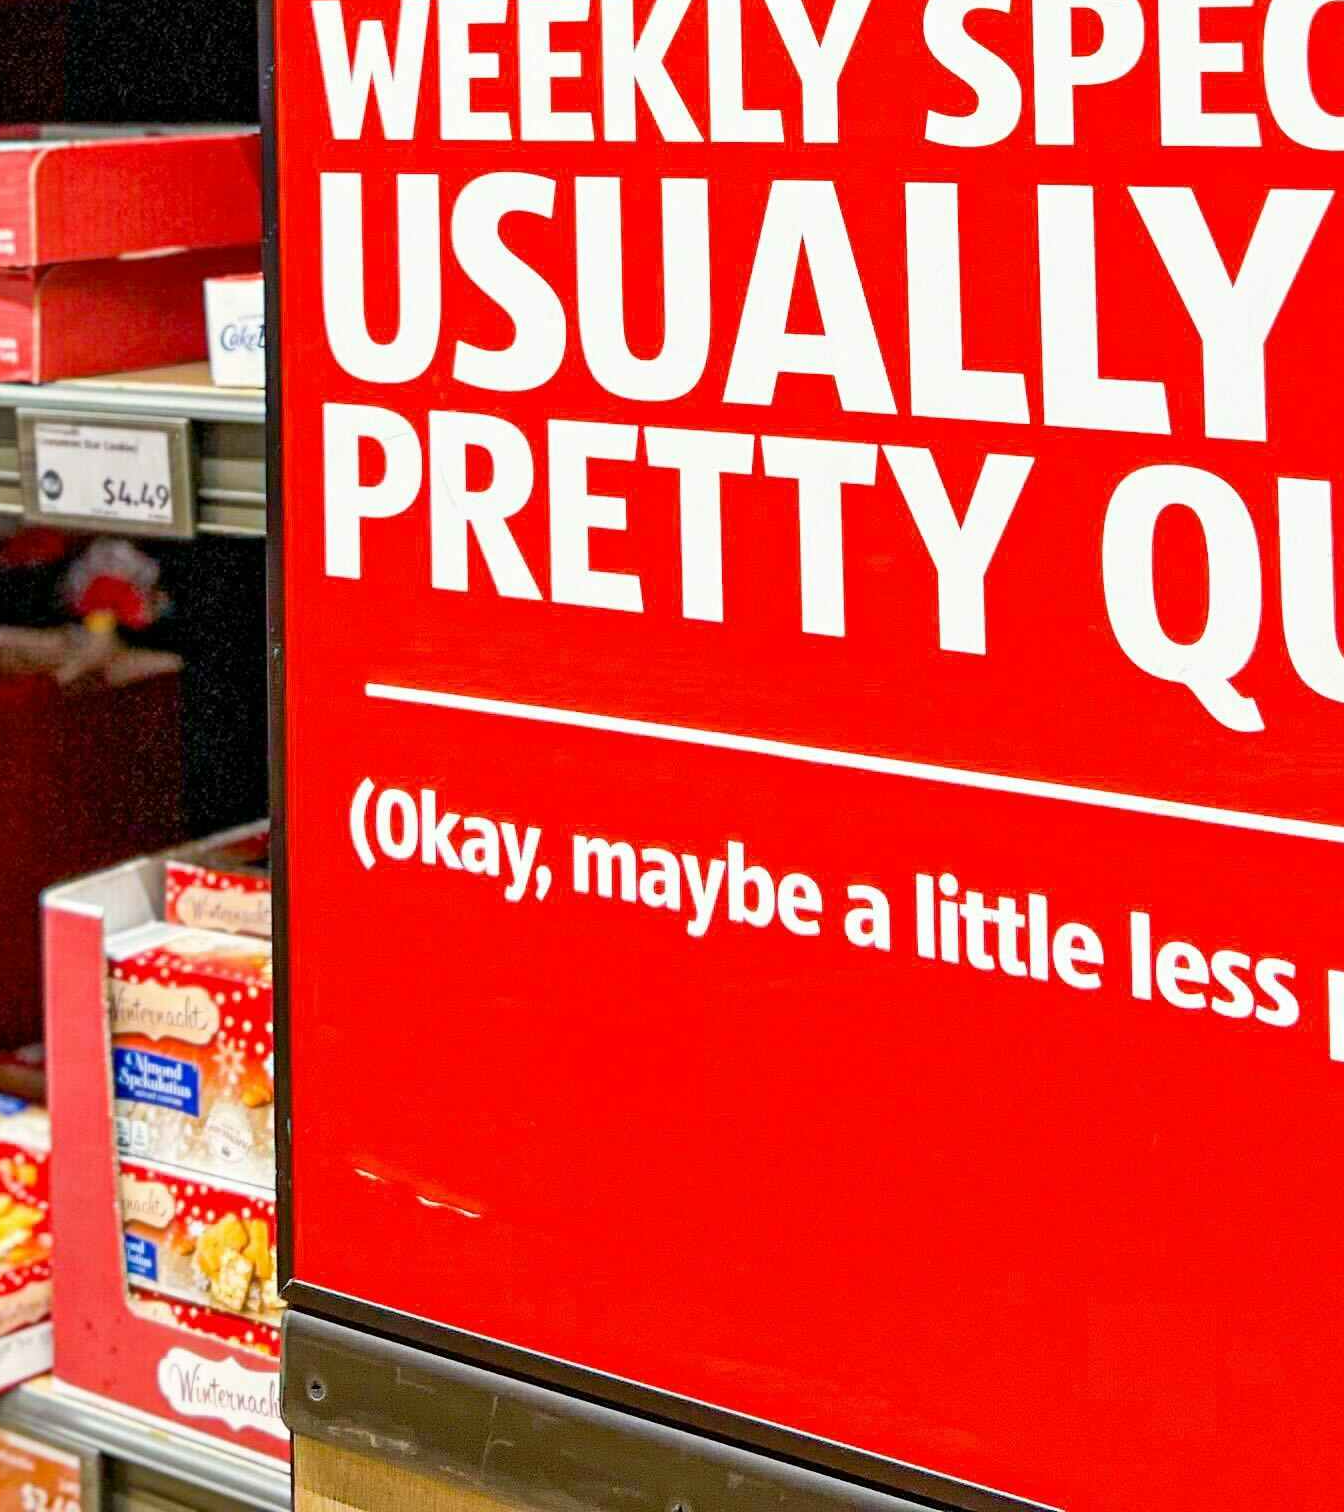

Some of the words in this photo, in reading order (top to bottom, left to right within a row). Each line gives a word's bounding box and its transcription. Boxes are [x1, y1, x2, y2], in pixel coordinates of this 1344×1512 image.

[320, 172, 1334, 442] USUALLY
[103, 475, 169, 509] $4.49
[323, 403, 1034, 655] PRETTY
[350, 777, 551, 902] (Okay,
[573, 835, 822, 936] maybe
[845, 885, 890, 951] a
[916, 873, 1104, 989] little
[1131, 911, 1299, 1026] less
[170, 1363, 282, 1419] Winternach
